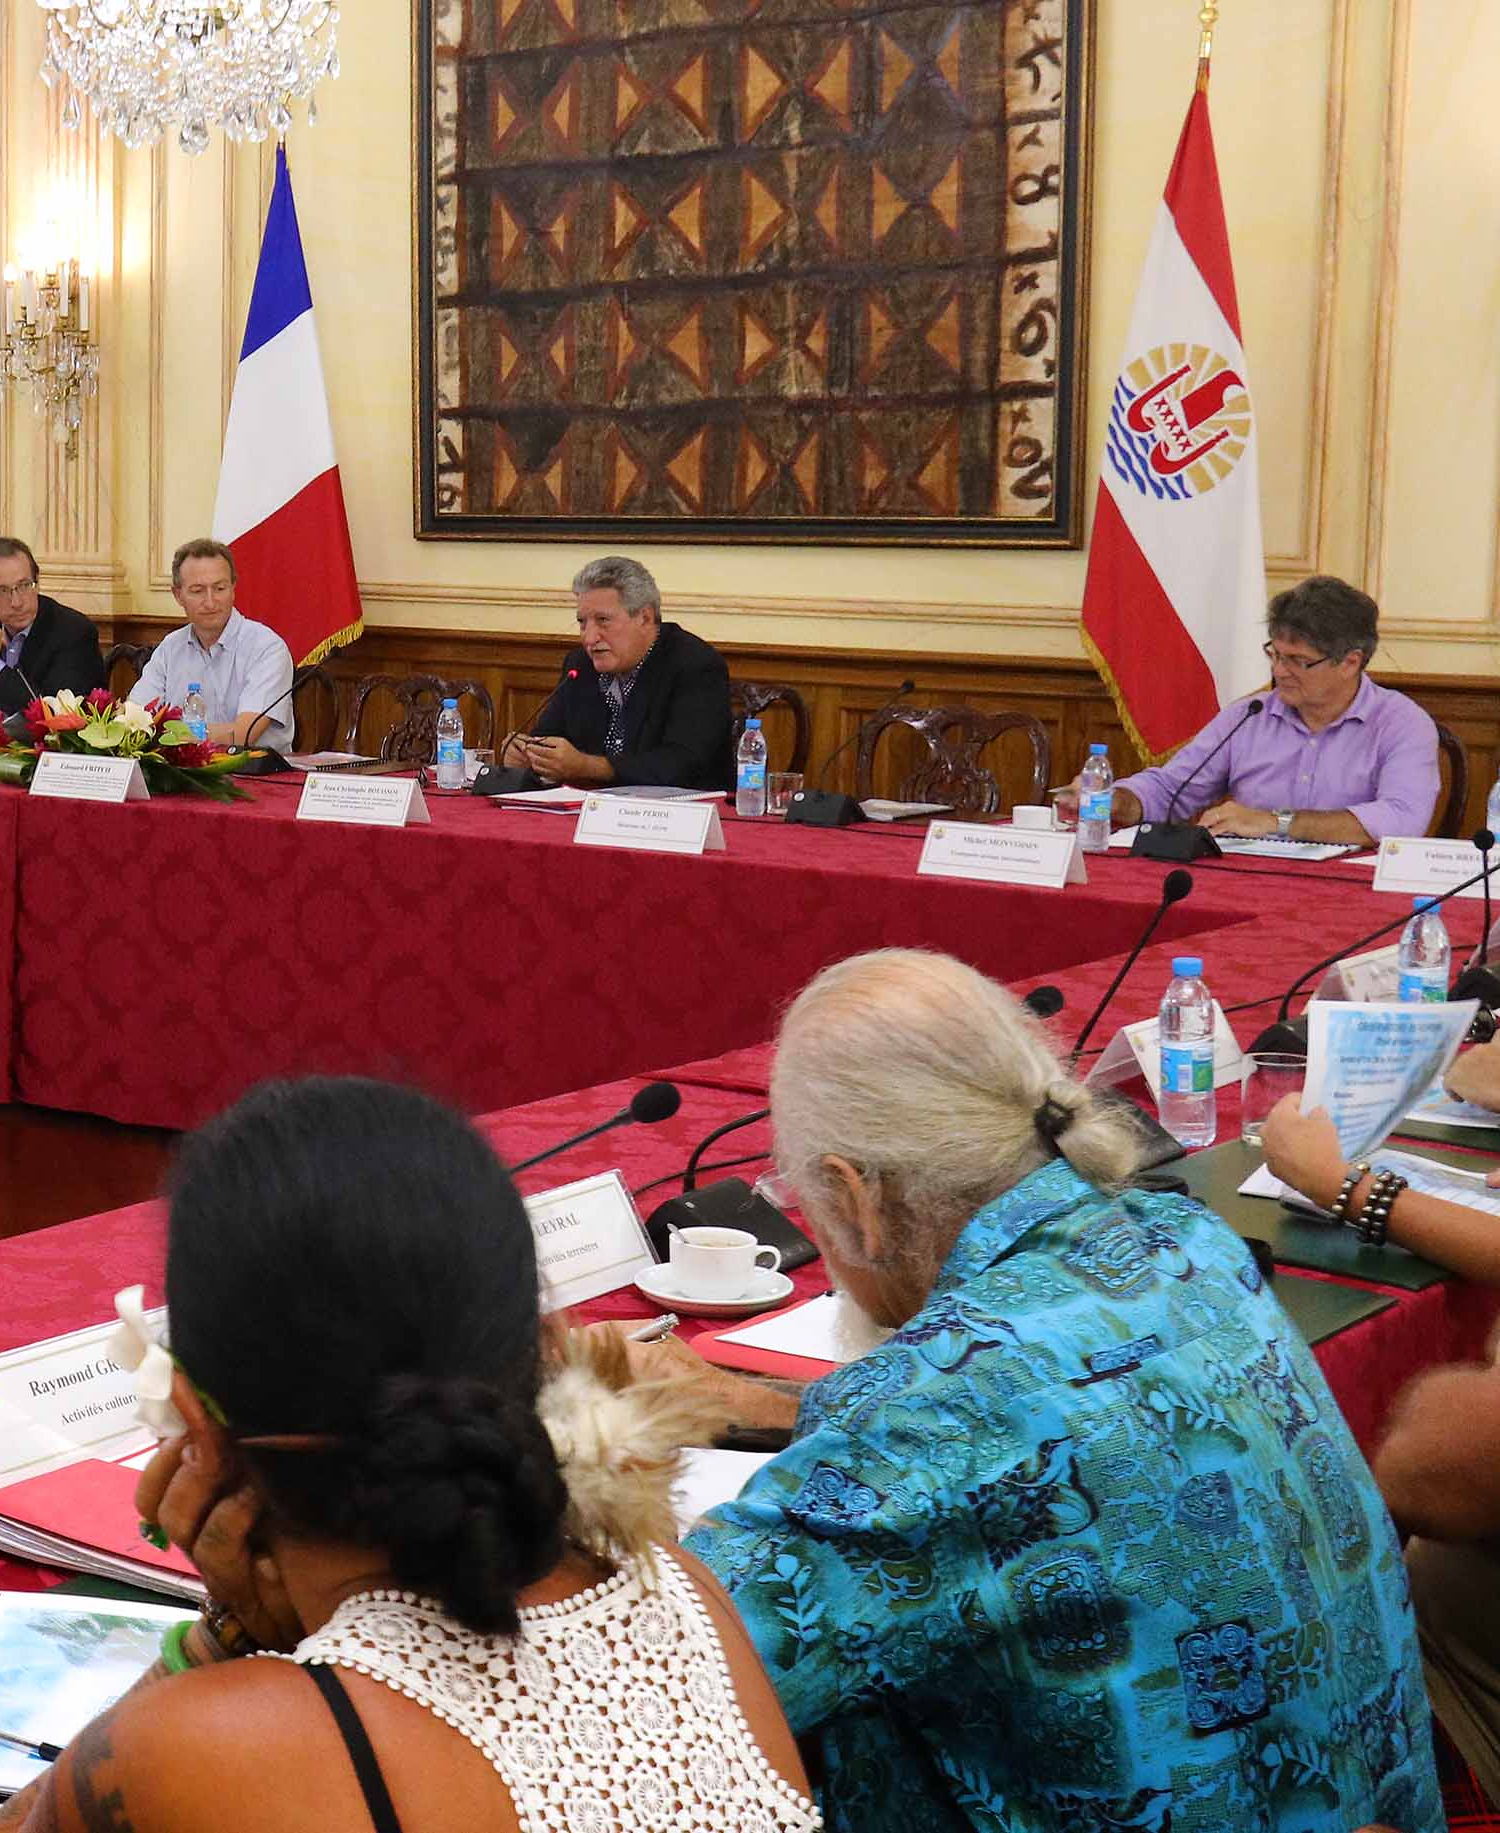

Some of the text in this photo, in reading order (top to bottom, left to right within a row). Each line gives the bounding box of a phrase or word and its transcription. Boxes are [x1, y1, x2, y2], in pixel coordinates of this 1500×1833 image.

[28, 1358, 123, 1397] Raymond GR
[61, 1402, 104, 1425] Activités
